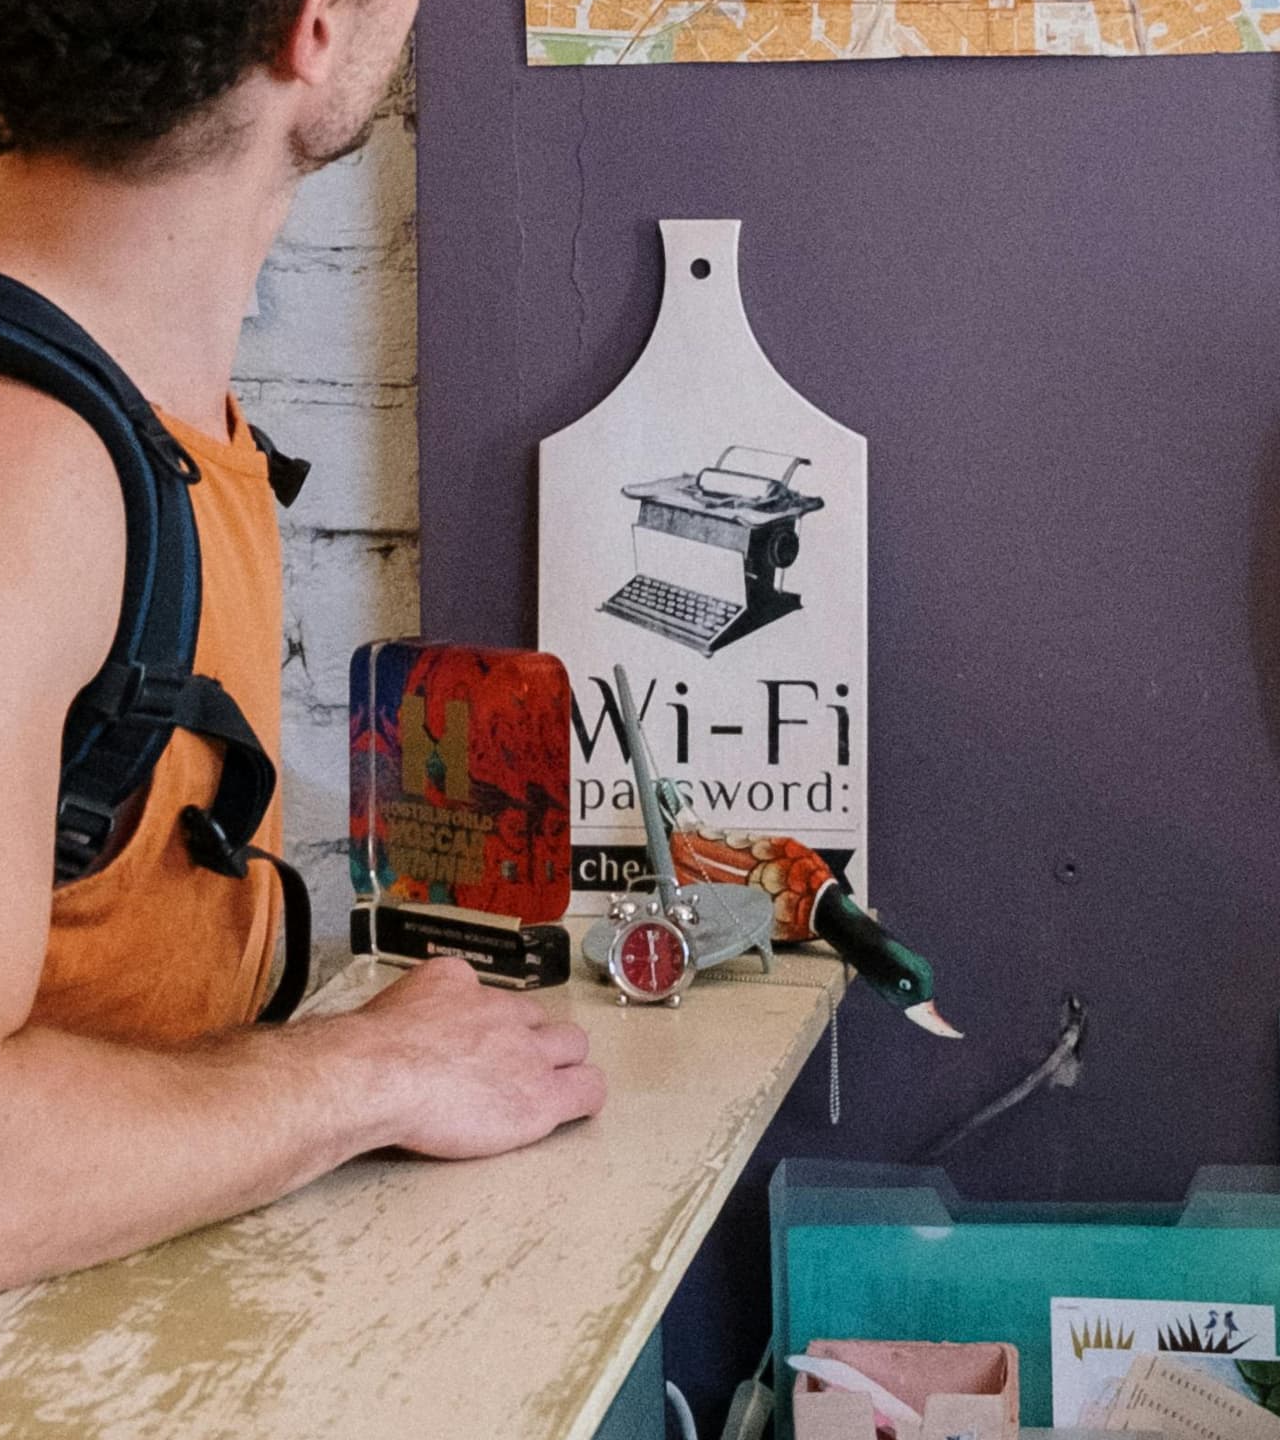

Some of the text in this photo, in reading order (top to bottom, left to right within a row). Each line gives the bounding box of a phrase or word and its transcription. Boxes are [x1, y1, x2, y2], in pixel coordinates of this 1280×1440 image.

[570, 676, 851, 766] Wi-Fi
[577, 771, 851, 821] pasword:
[579, 852, 649, 881] che
